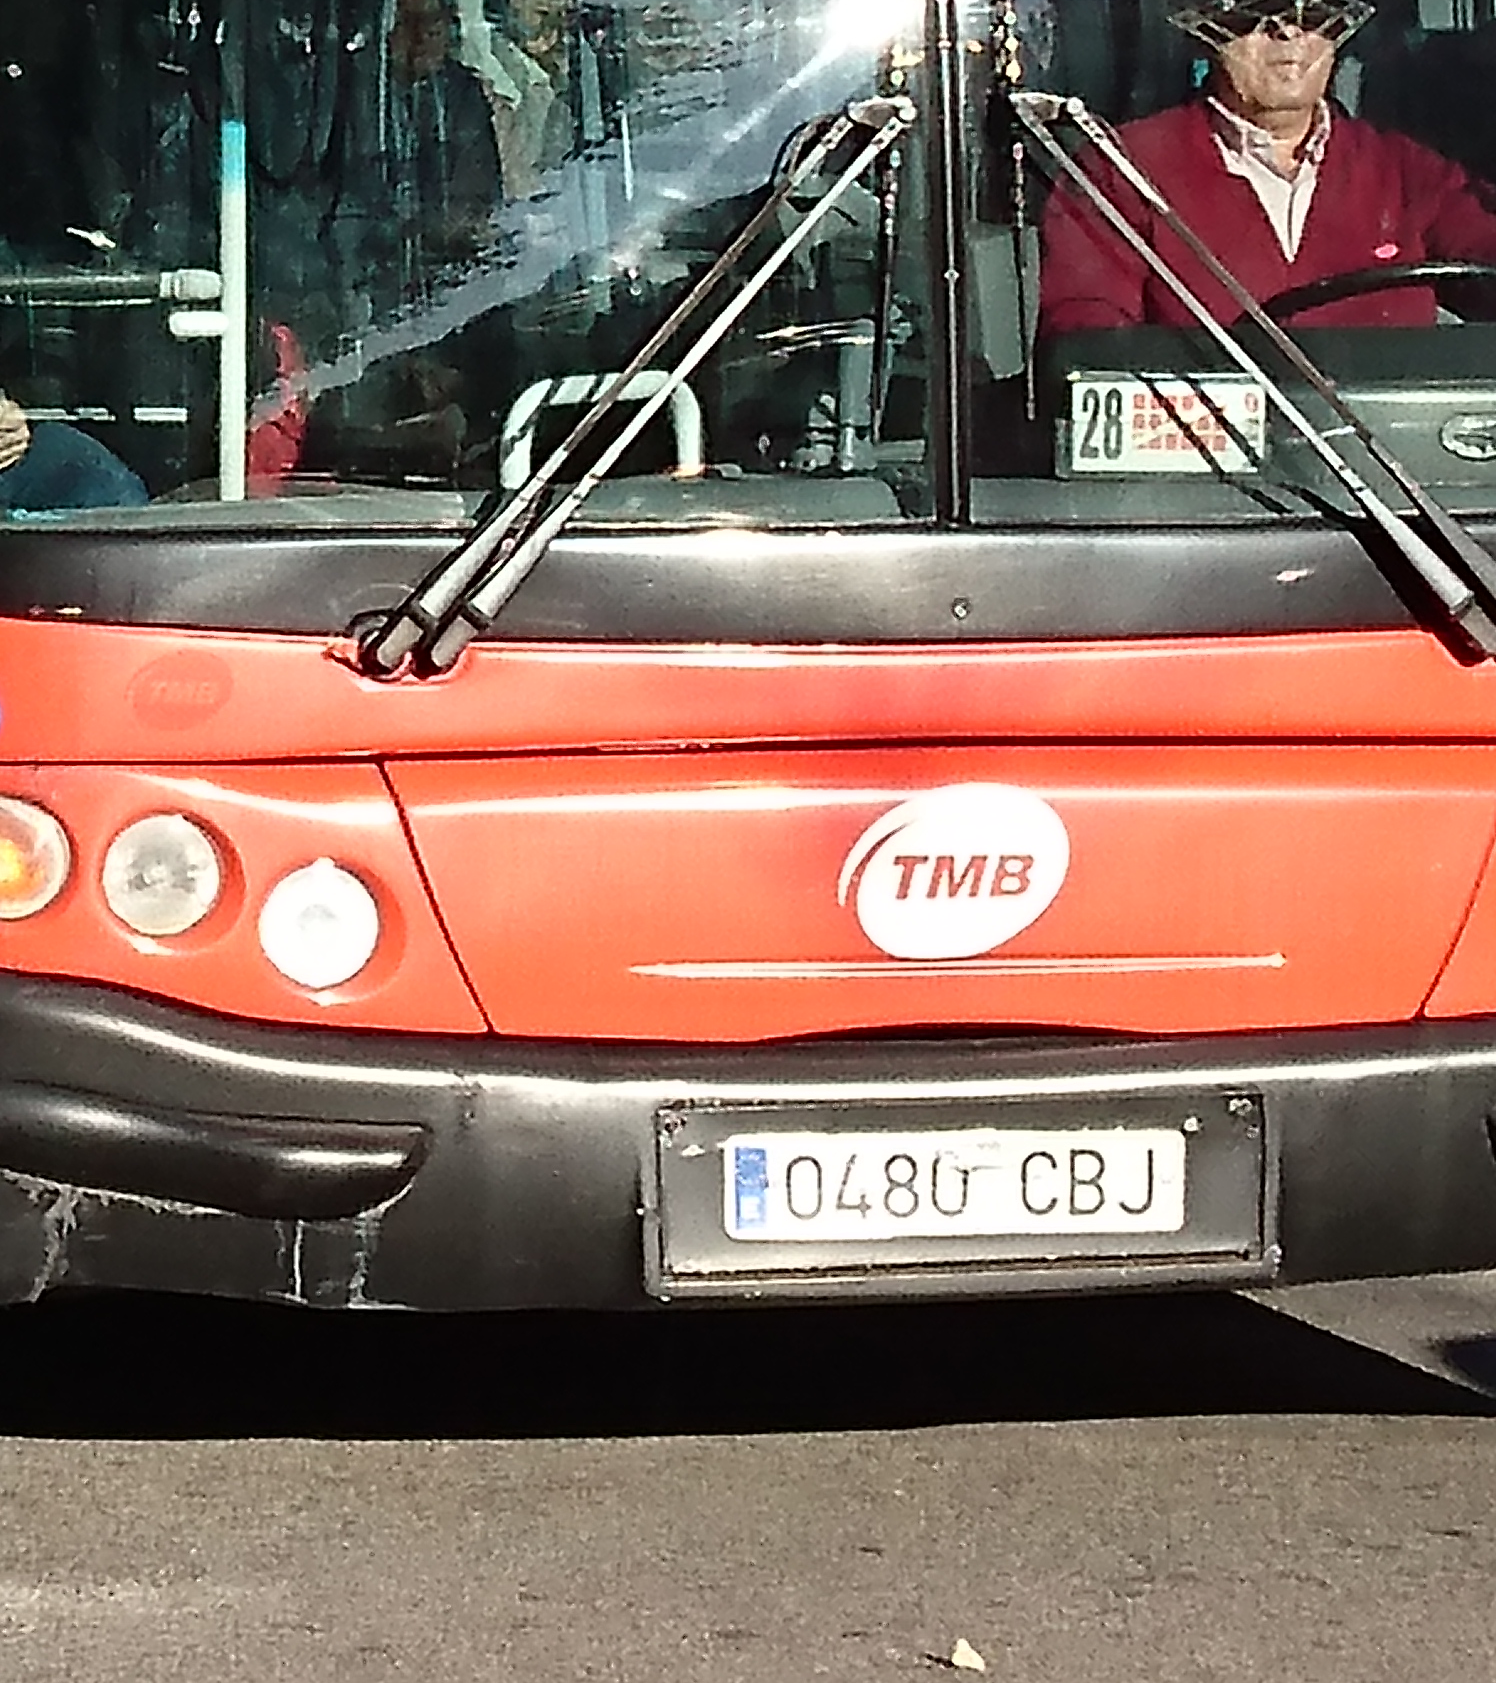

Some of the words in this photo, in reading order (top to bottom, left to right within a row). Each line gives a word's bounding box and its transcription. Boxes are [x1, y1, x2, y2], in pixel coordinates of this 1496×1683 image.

[1079, 387, 1124, 460] 28
[893, 854, 1034, 900] TMB
[784, 1153, 969, 1221] 0480
[1020, 1148, 1156, 1216] CBJ
